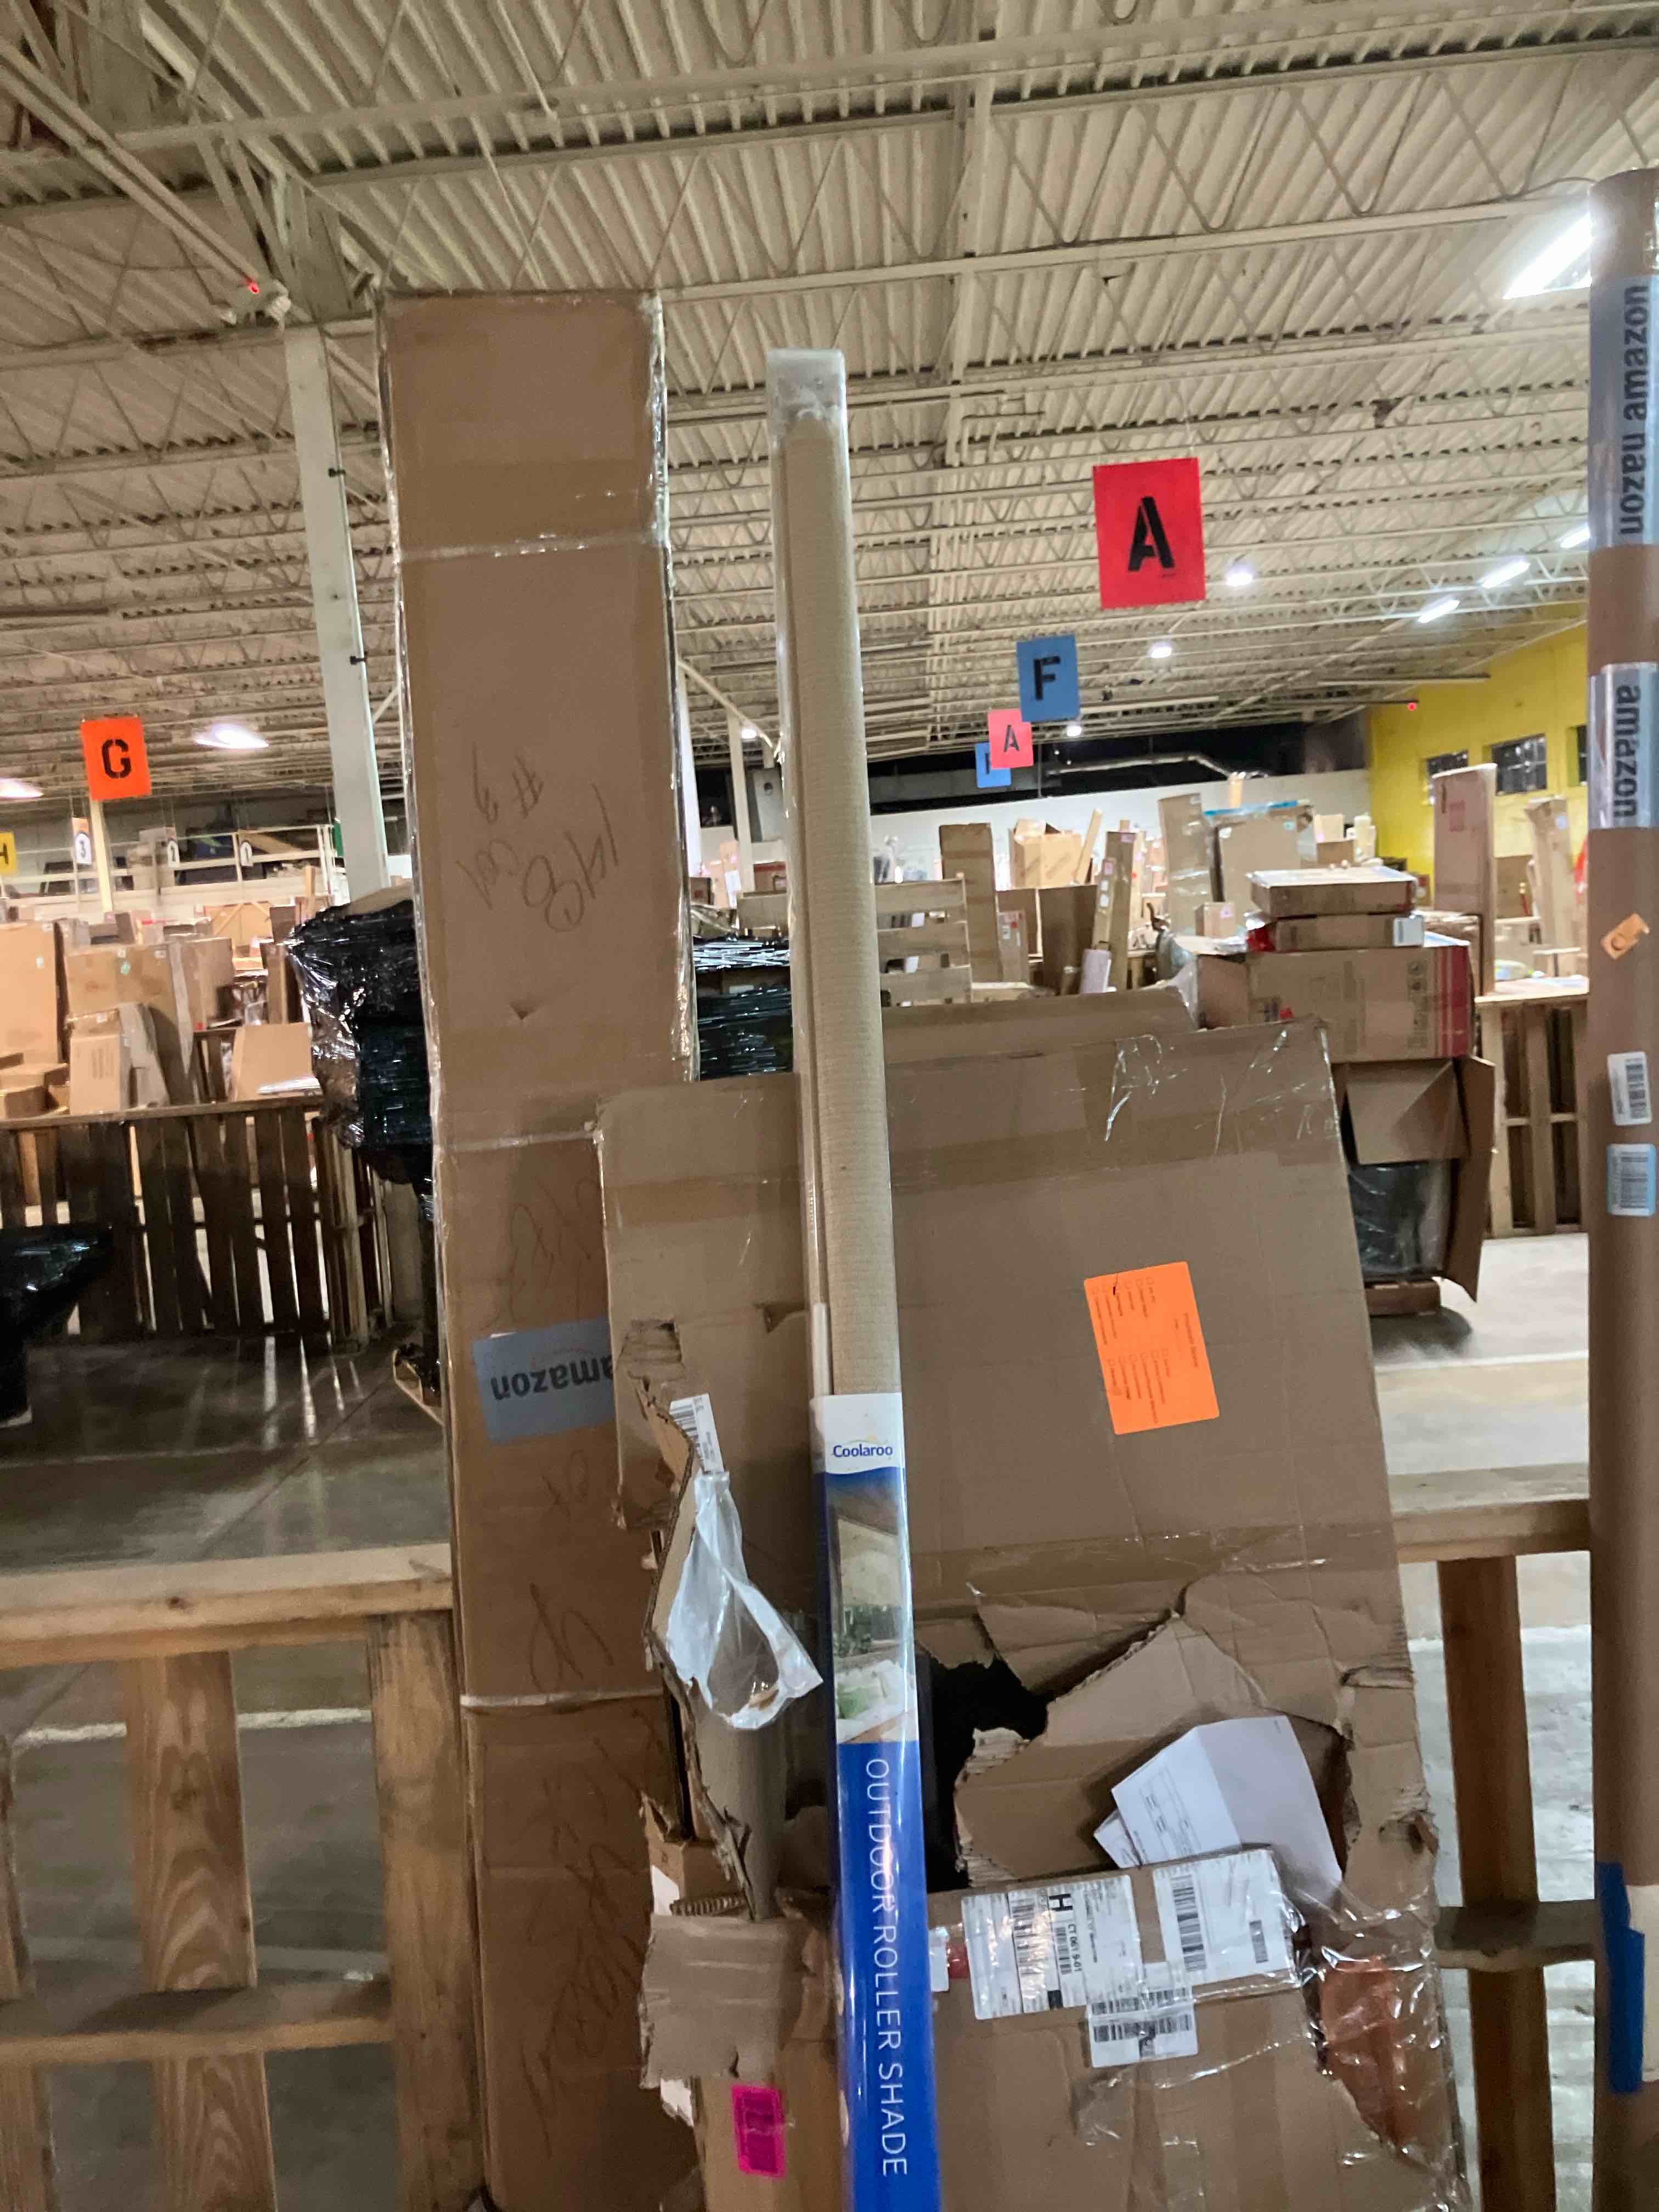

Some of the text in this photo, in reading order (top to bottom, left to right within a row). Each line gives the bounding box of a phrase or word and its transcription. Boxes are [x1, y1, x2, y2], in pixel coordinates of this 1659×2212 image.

[1624, 285, 1649, 421] amazon
[1128, 495, 1175, 572] A
[1034, 656, 1061, 701] F
[101, 739, 132, 779] G
[1003, 724, 1020, 753] A
[1614, 685, 1641, 818] amazon
[833, 1443, 893, 1458] Coolaroo
[1049, 1893, 1074, 1911] H
[1069, 1924, 1076, 1934] CT
[866, 1758, 907, 2177] OUTDOOR ROLLER SHADE
